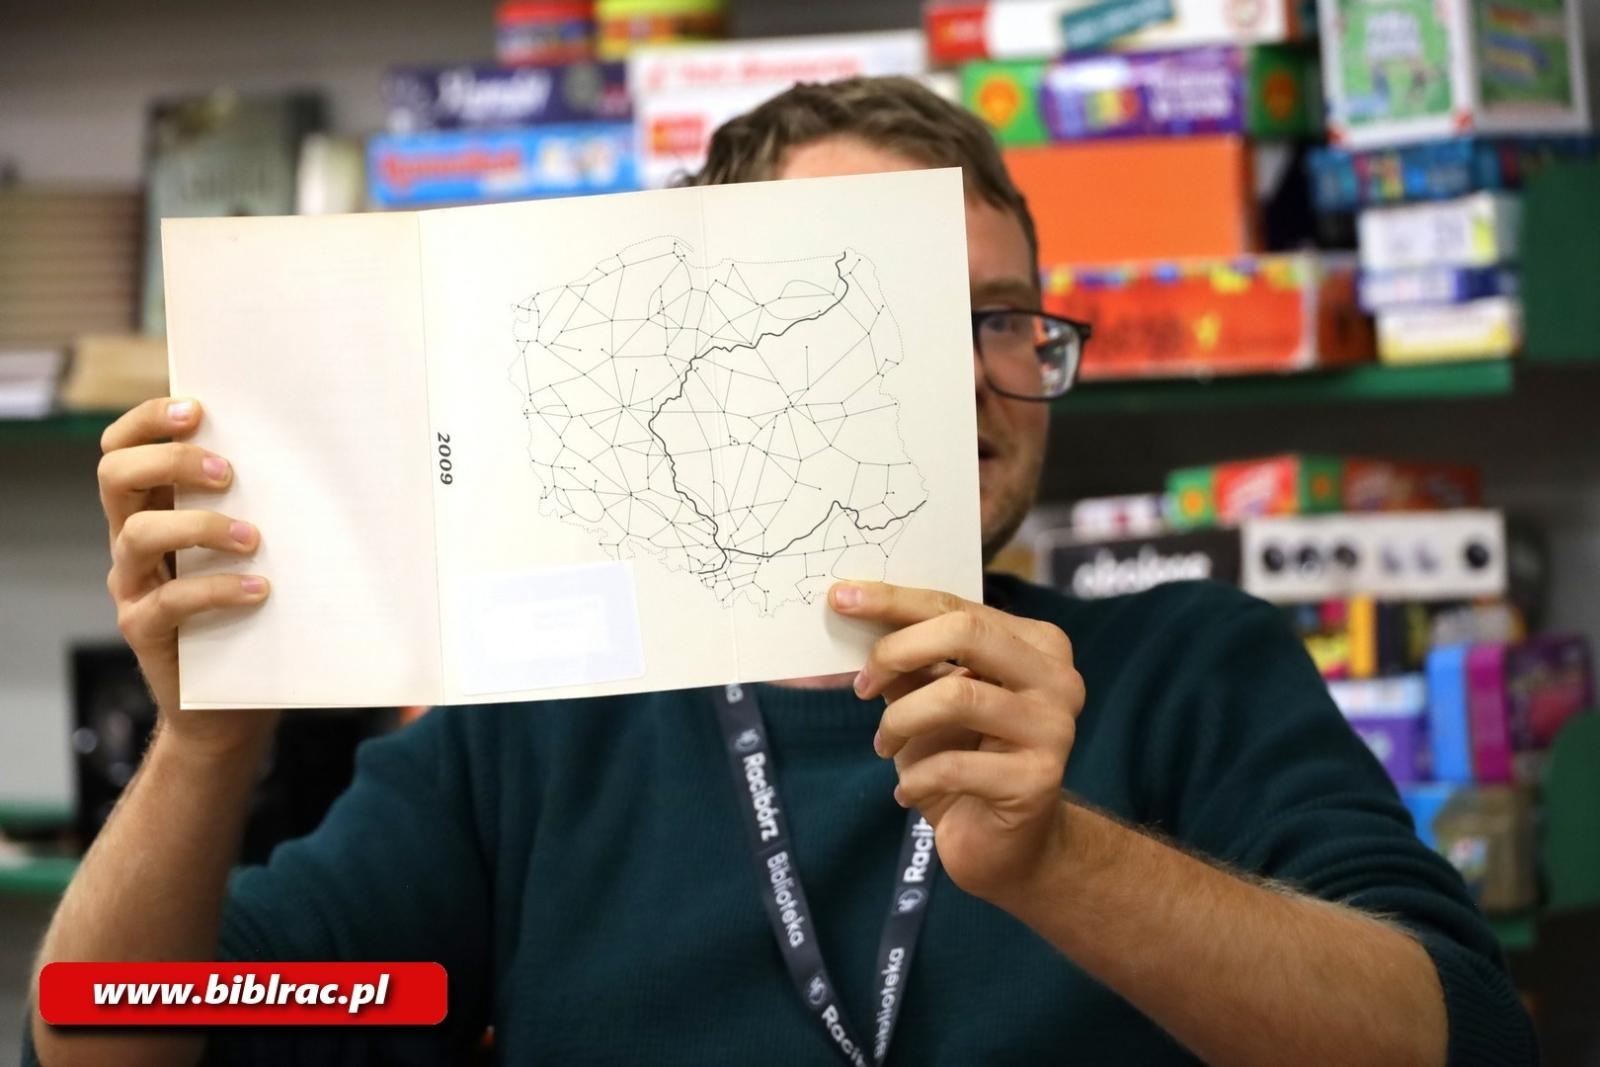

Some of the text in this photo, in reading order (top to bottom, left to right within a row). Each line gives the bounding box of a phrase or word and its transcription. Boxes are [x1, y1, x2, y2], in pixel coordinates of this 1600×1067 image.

[437, 431, 453, 485] 2009
[743, 751, 805, 948] Racibórz Biblioteka
[903, 816, 934, 882] Racib
